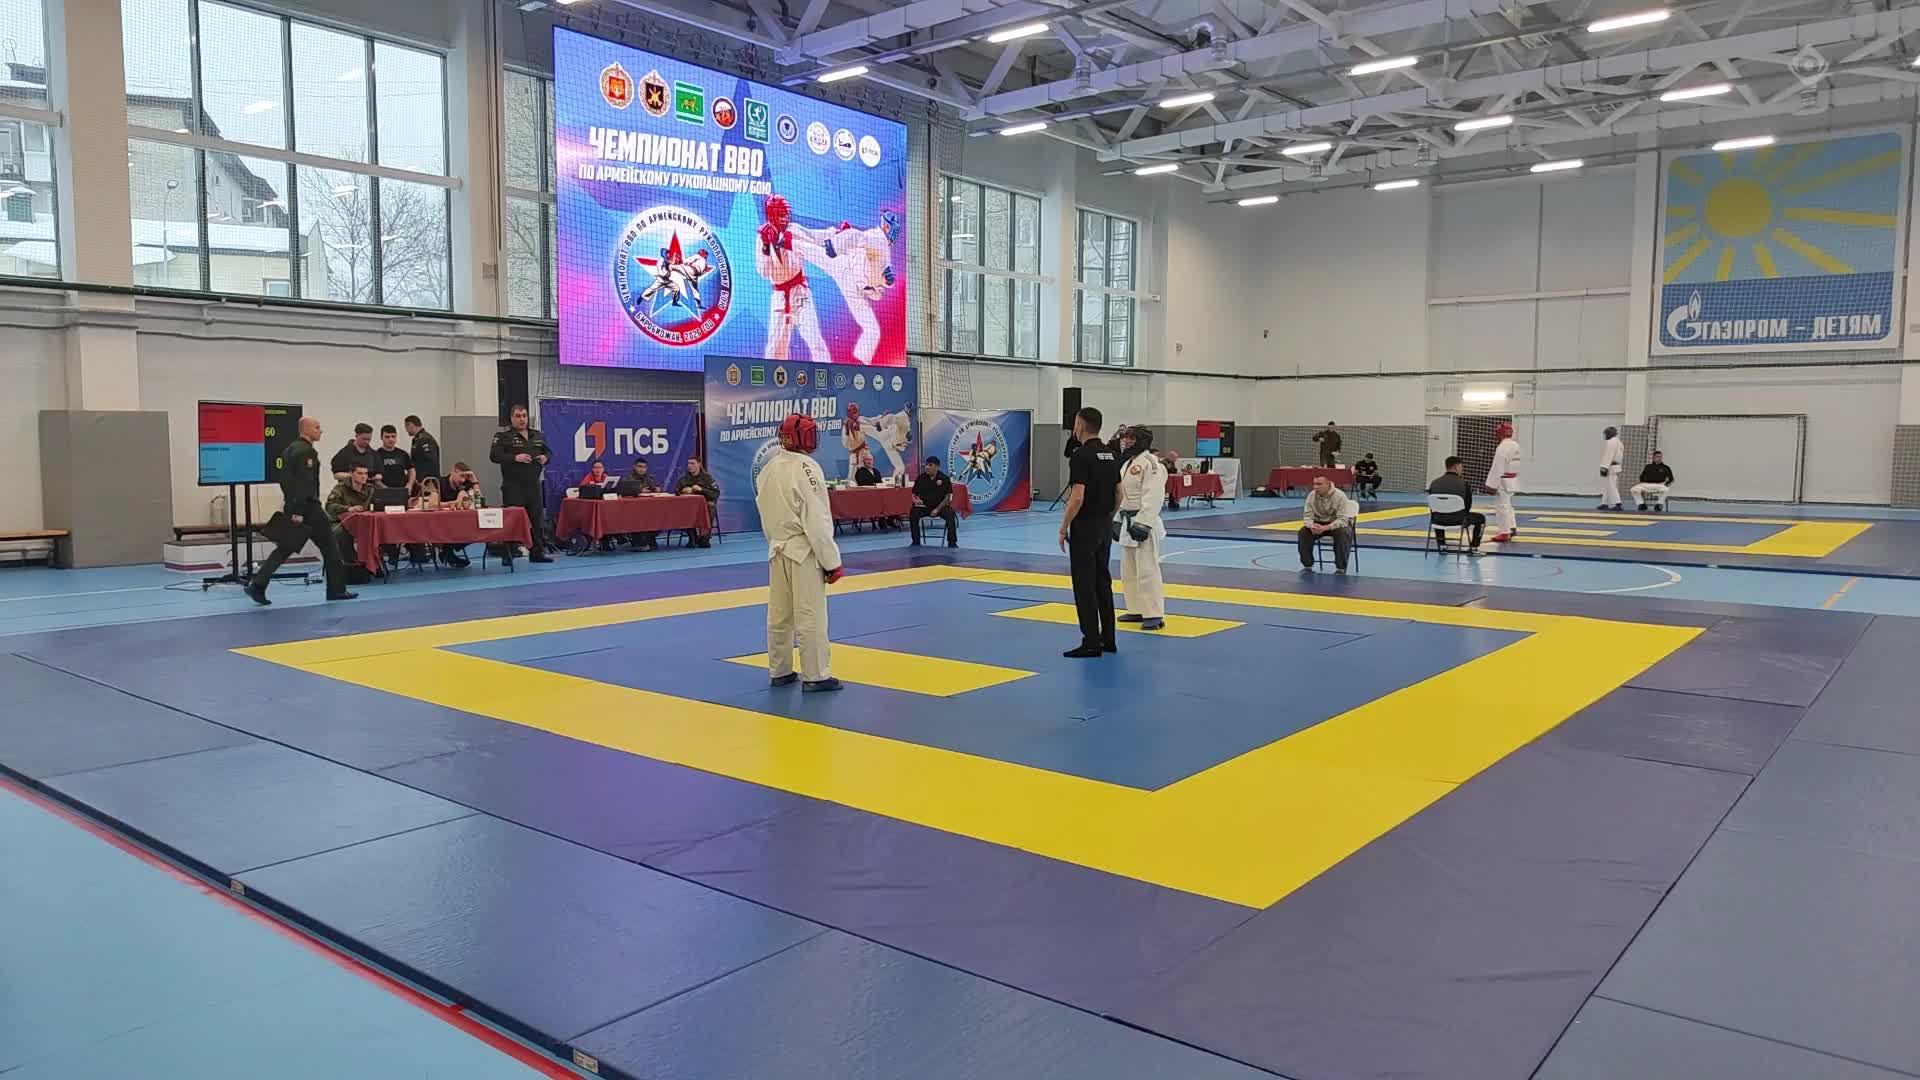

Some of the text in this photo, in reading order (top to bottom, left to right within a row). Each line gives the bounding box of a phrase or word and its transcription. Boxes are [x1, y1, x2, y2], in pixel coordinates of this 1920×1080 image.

[590, 126, 721, 172] ЧЕМПИОНАТ
[724, 145, 764, 177] ВВО
[578, 164, 772, 195] ПО АРМЕЙСКОМУ РУКОПАШНОМУ БОЮ
[617, 249, 631, 303] ЧЕМПИОНАТ
[626, 231, 638, 247] ВВО
[636, 220, 647, 231] ПО
[648, 210, 698, 228] АРМЕЙСКОМУ
[1702, 318, 1788, 340] ГАЗПРОМ
[1812, 314, 1881, 339] ДЕТЯМ
[811, 396, 837, 419] ВВО
[614, 427, 670, 456] ПСБ
[720, 430, 731, 442] ПО
[731, 426, 777, 441] АРМЕЙСКОМУ
[827, 418, 842, 431] БОЮ
